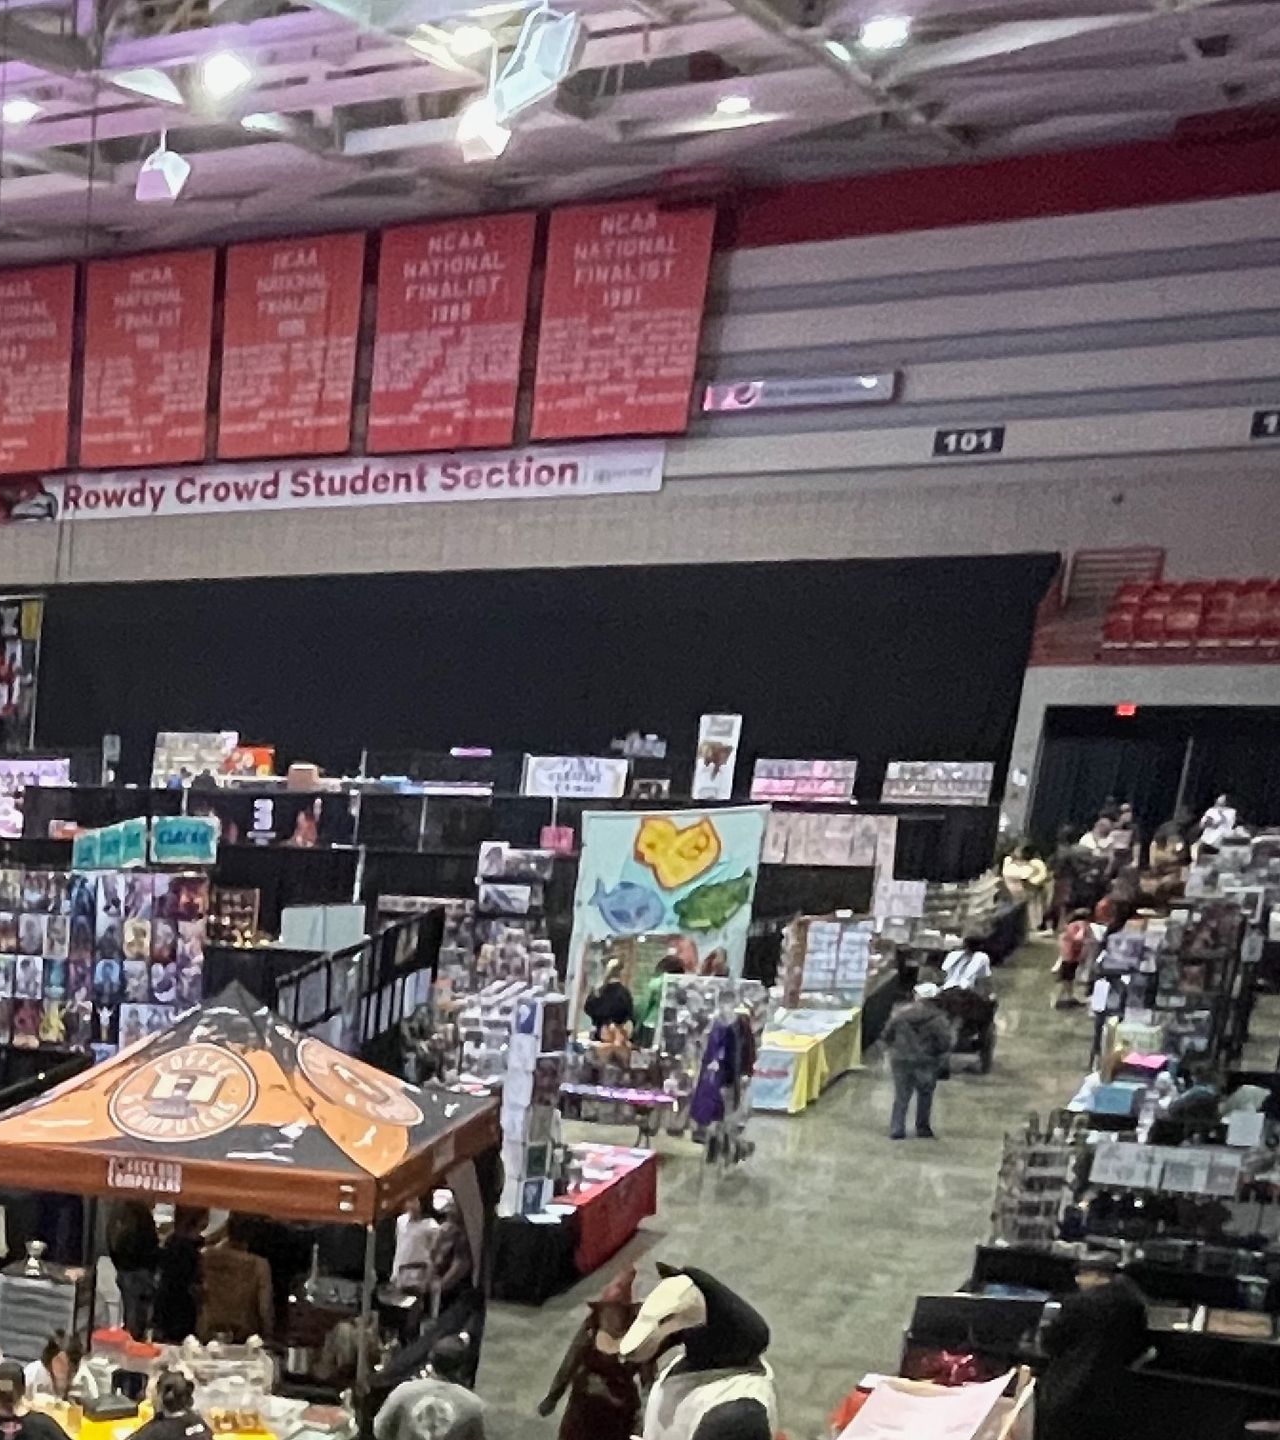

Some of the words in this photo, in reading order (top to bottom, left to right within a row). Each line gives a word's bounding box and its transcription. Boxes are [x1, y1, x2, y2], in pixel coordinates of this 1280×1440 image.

[600, 212, 657, 235] NCAA
[427, 231, 486, 254] NCAA
[574, 234, 678, 260] NATIONAL
[403, 251, 507, 279] NATIONAL
[574, 259, 676, 288] FINALIST
[405, 275, 501, 301] FINALIST
[943, 430, 993, 453] 101
[62, 478, 166, 513] Rowdy
[174, 468, 280, 505] Crowd
[289, 461, 428, 499] Student
[439, 456, 579, 491] Section
[154, 1049, 239, 1080] COFFEE
[119, 1093, 239, 1135] COMPUTERS
